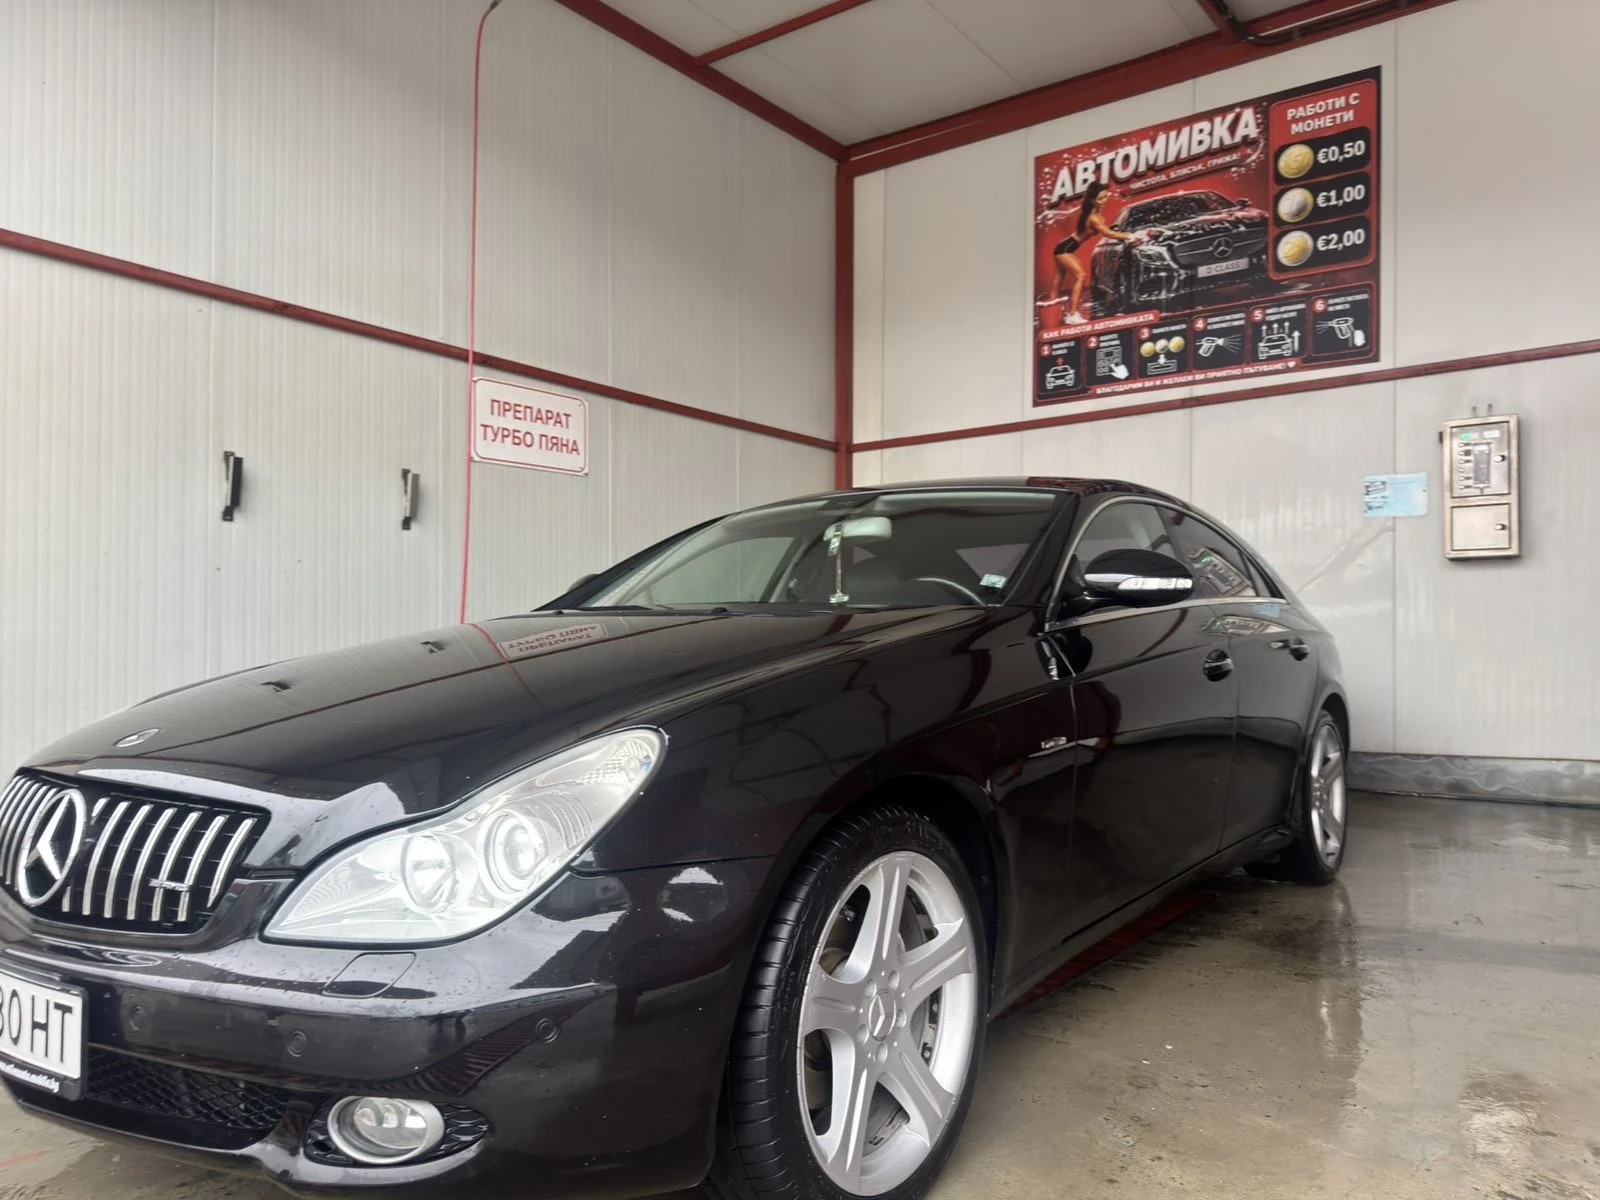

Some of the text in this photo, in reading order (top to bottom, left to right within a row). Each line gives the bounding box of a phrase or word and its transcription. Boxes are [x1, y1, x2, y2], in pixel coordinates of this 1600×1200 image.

[1287, 93, 1360, 120] РАБОТИ С
[1291, 110, 1354, 135] МОНЕТИ
[1050, 107, 1258, 204] АВТОМИВКА
[1317, 140, 1366, 164] €0,50
[1316, 185, 1366, 208] €1,00
[1316, 229, 1365, 251] €2,00
[1253, 310, 1262, 320] 5
[1316, 301, 1324, 310] 6
[1043, 331, 1060, 340] КАК
[1061, 324, 1093, 337] РАБОТИ
[1093, 313, 1155, 330] АВТОМИВКАТА
[1141, 329, 1149, 338] 3
[1196, 319, 1203, 329] 4
[1090, 337, 1097, 347] 2
[490, 398, 572, 429] ПРЕПАРАТ
[480, 423, 580, 455] ТУРБО ПЯНА
